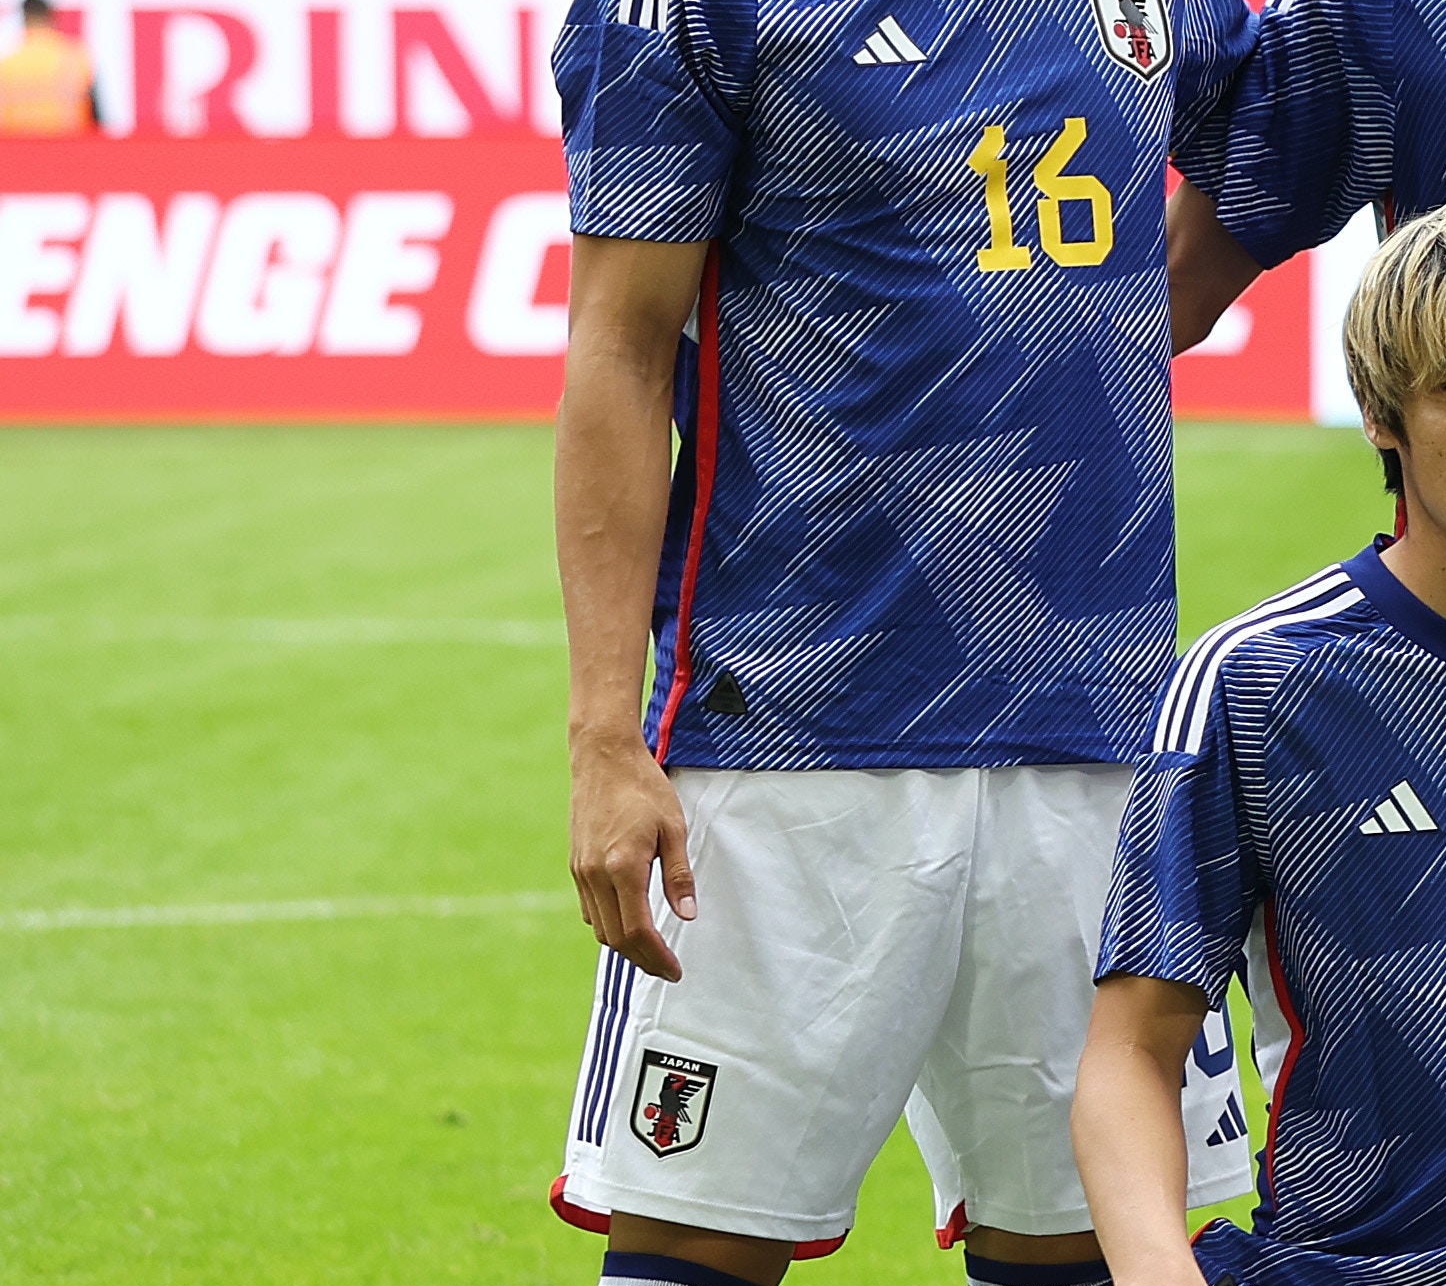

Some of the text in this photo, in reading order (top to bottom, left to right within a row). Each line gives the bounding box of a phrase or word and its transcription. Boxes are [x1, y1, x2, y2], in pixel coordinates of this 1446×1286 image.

[1128, 38, 1156, 61] JFA
[967, 117, 1113, 271] 16
[659, 1055, 701, 1073] JAPAN
[646, 1122, 681, 1145] JFA
